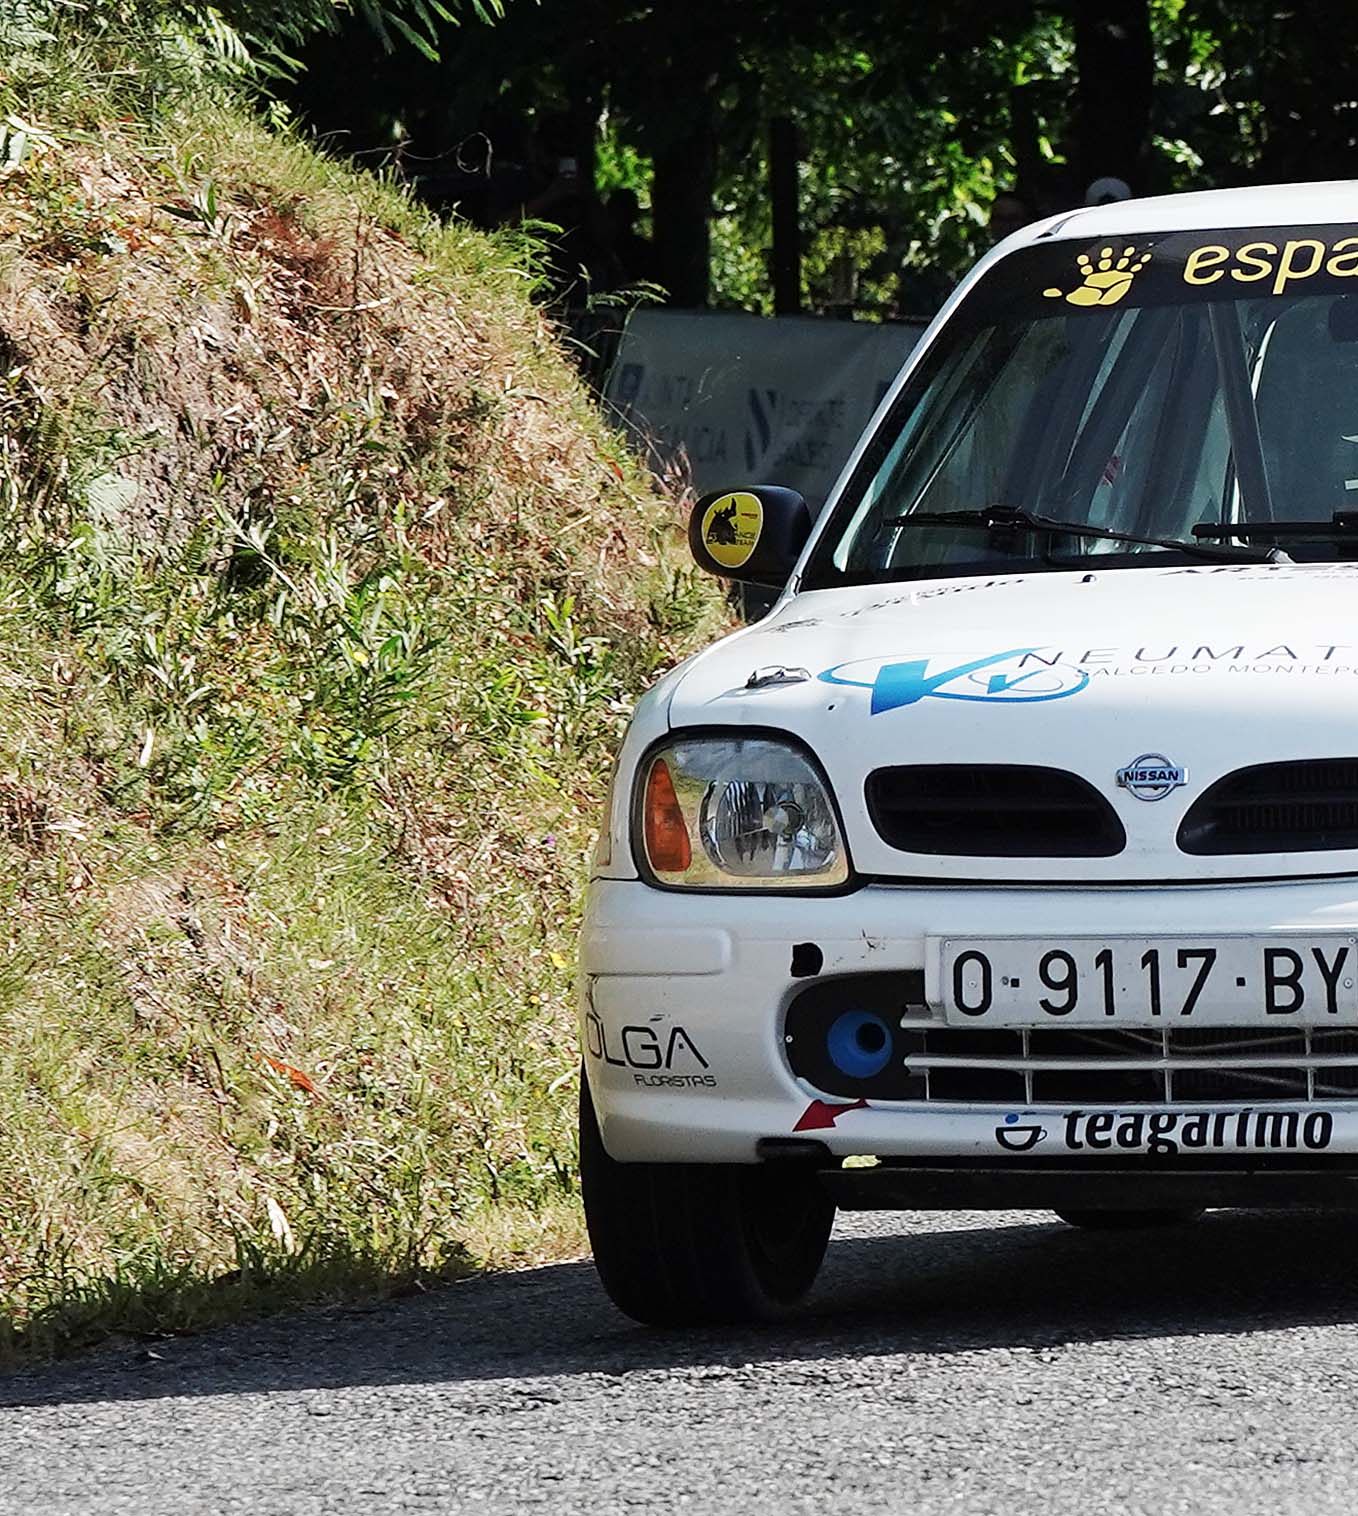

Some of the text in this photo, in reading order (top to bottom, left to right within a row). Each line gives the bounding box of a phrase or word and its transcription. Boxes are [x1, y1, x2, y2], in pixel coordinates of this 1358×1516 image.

[1124, 770, 1178, 782] NISSAN
[1038, 948, 1217, 1017] 9117
[1264, 947, 1349, 1015] BY
[633, 1074, 717, 1087] FLORISTAS
